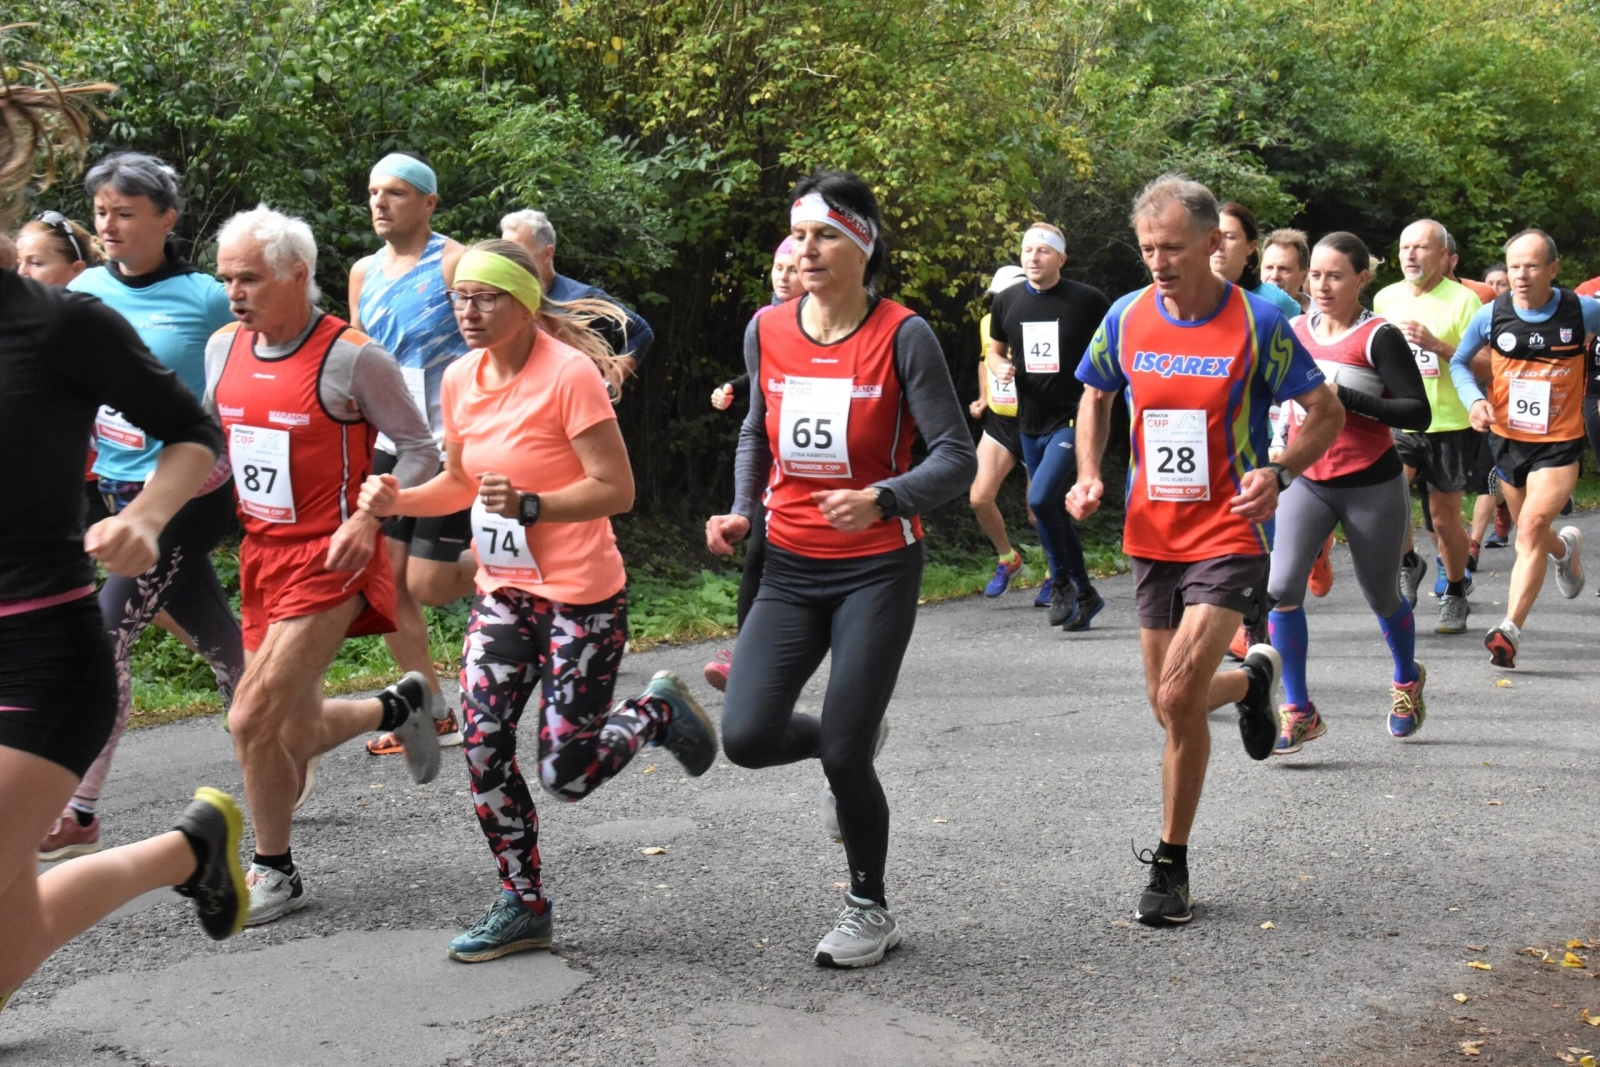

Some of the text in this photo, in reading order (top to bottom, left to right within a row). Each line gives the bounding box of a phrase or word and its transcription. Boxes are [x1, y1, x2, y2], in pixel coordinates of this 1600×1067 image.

[1031, 342, 1052, 357] 42
[1133, 352, 1235, 378] ISCAREX
[852, 384, 882, 394] RATON
[1516, 400, 1540, 416] 96
[793, 418, 832, 449] 65
[1147, 419, 1168, 427] CUP
[234, 435, 254, 444] CUP
[1157, 447, 1196, 474] 28
[244, 464, 277, 494] 87
[482, 526, 519, 557] 74
